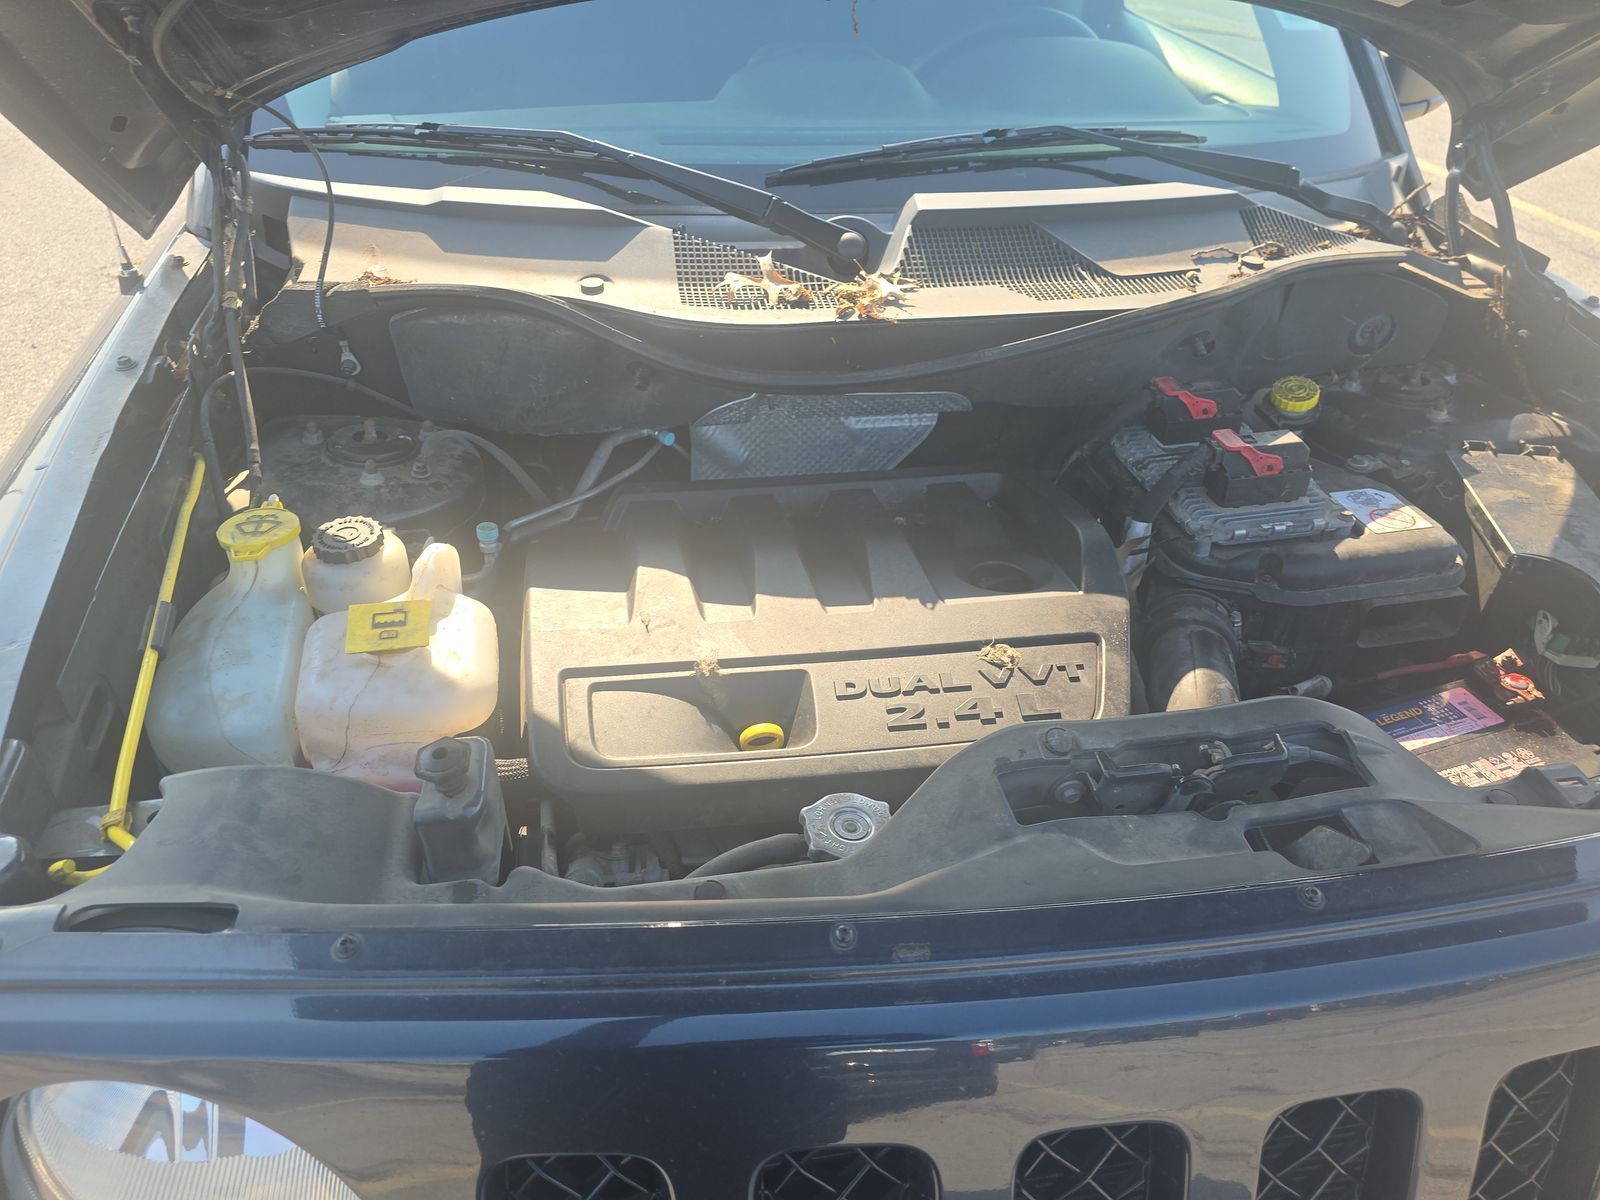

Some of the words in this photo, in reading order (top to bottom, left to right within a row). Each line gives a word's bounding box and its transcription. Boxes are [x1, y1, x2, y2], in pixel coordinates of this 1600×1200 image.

[833, 672, 973, 701] DUAL
[977, 663, 1085, 689] VVT
[1375, 707, 1423, 726] LEGEND
